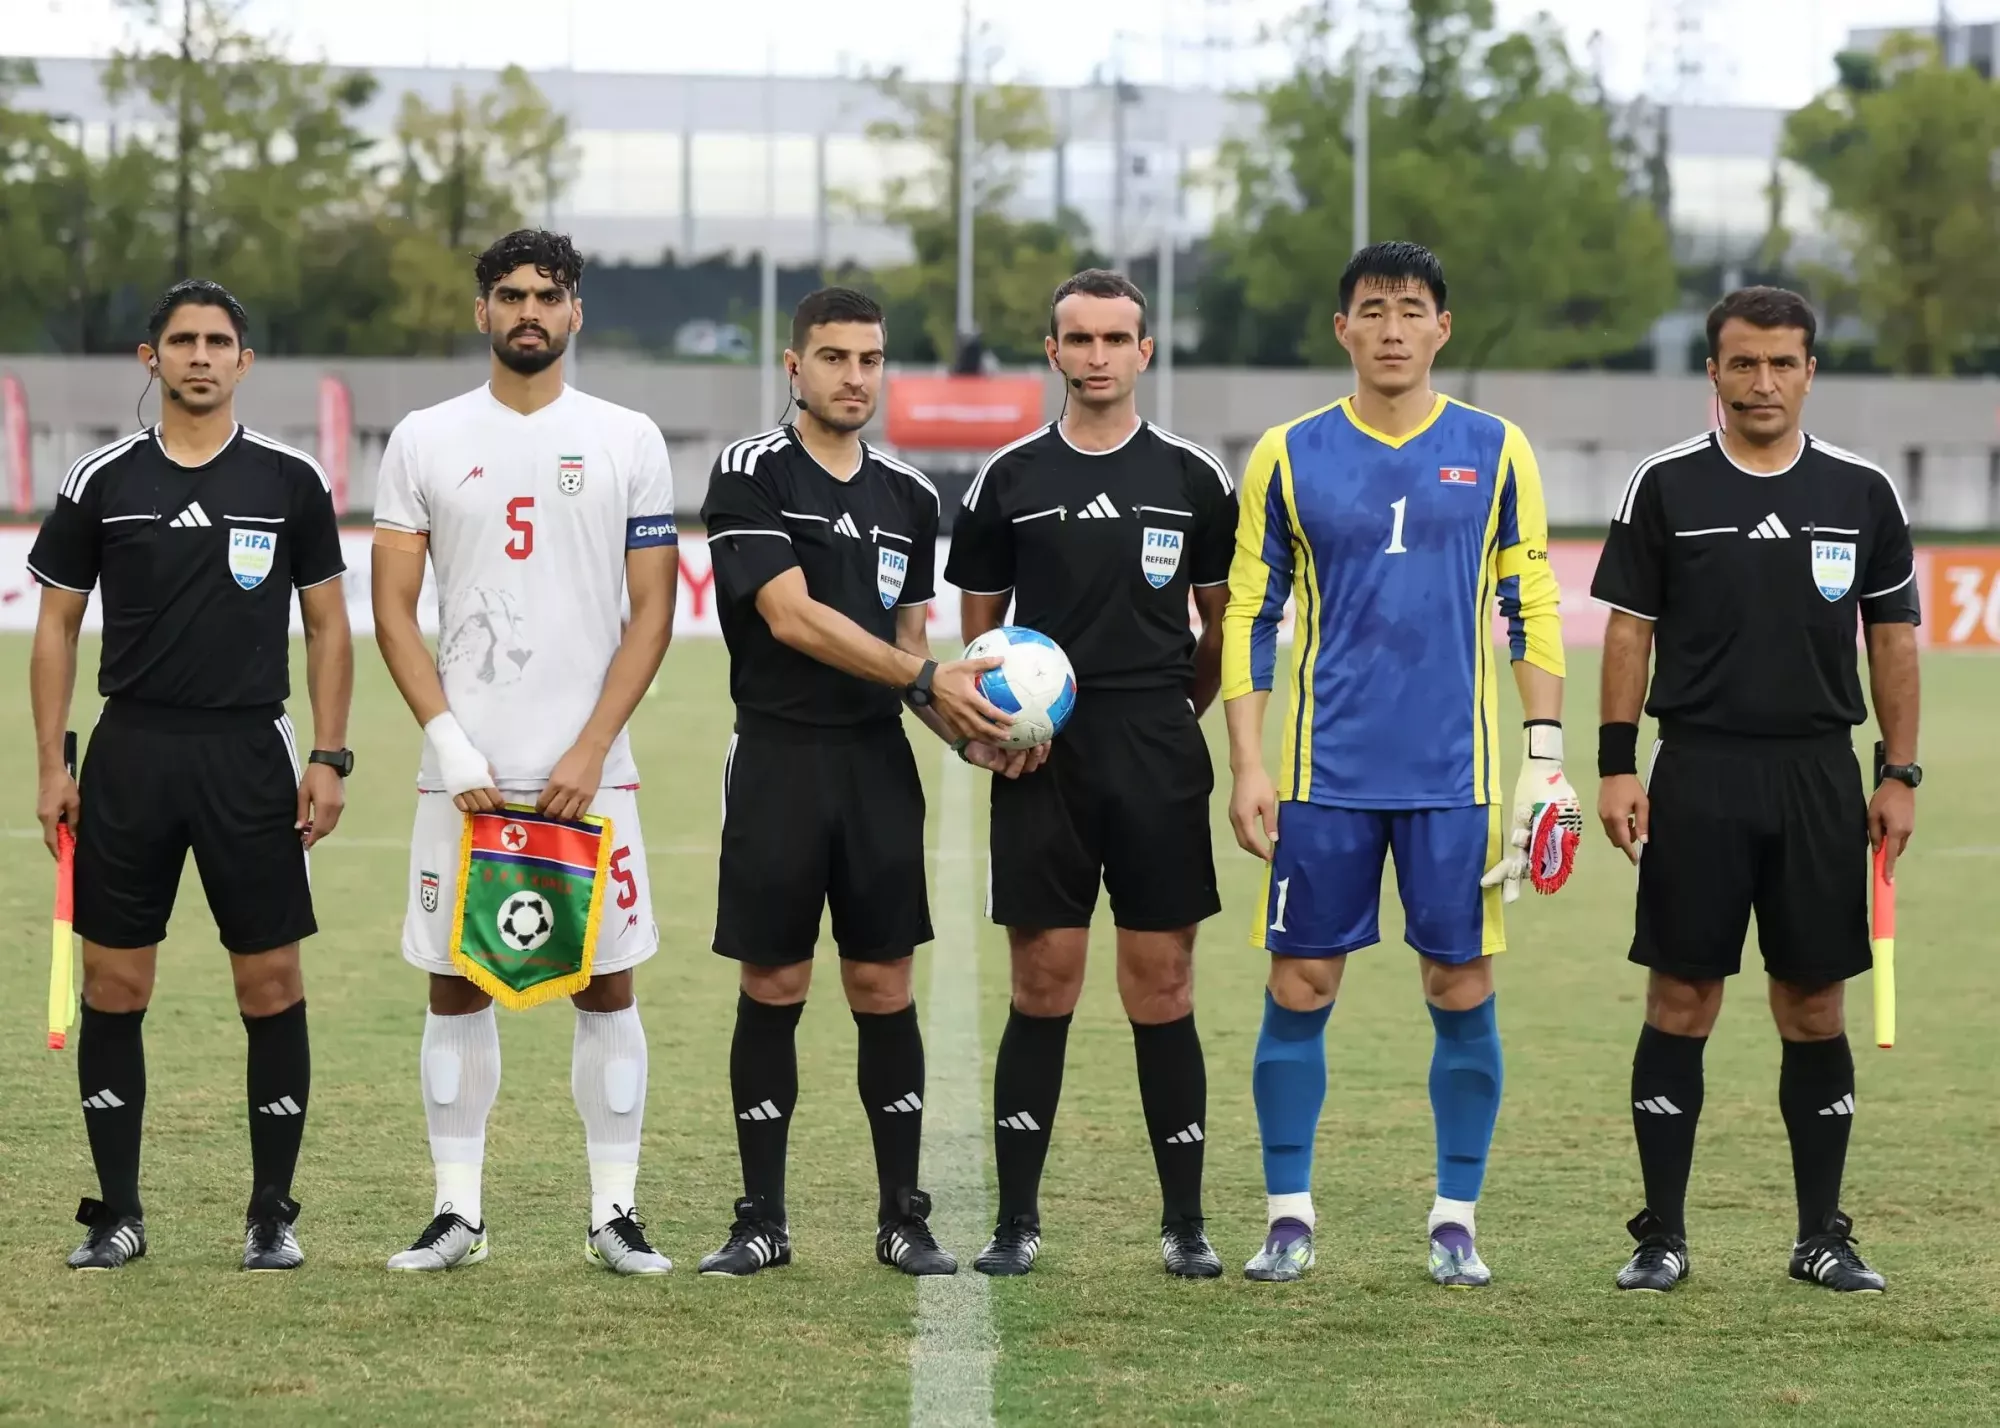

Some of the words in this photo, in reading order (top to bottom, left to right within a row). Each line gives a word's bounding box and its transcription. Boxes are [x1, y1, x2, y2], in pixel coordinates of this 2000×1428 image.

[505, 496, 535, 560] 5
[1385, 496, 1407, 554] 1
[234, 532, 271, 551] FIFA
[1148, 531, 1180, 550] FIFA
[882, 551, 906, 572] FIFA
[1145, 555, 1177, 566] REFEREE
[1816, 545, 1852, 561] FIFA
[880, 574, 902, 589] REFEREE
[610, 845, 638, 910] 5
[1270, 877, 1290, 932] 1
